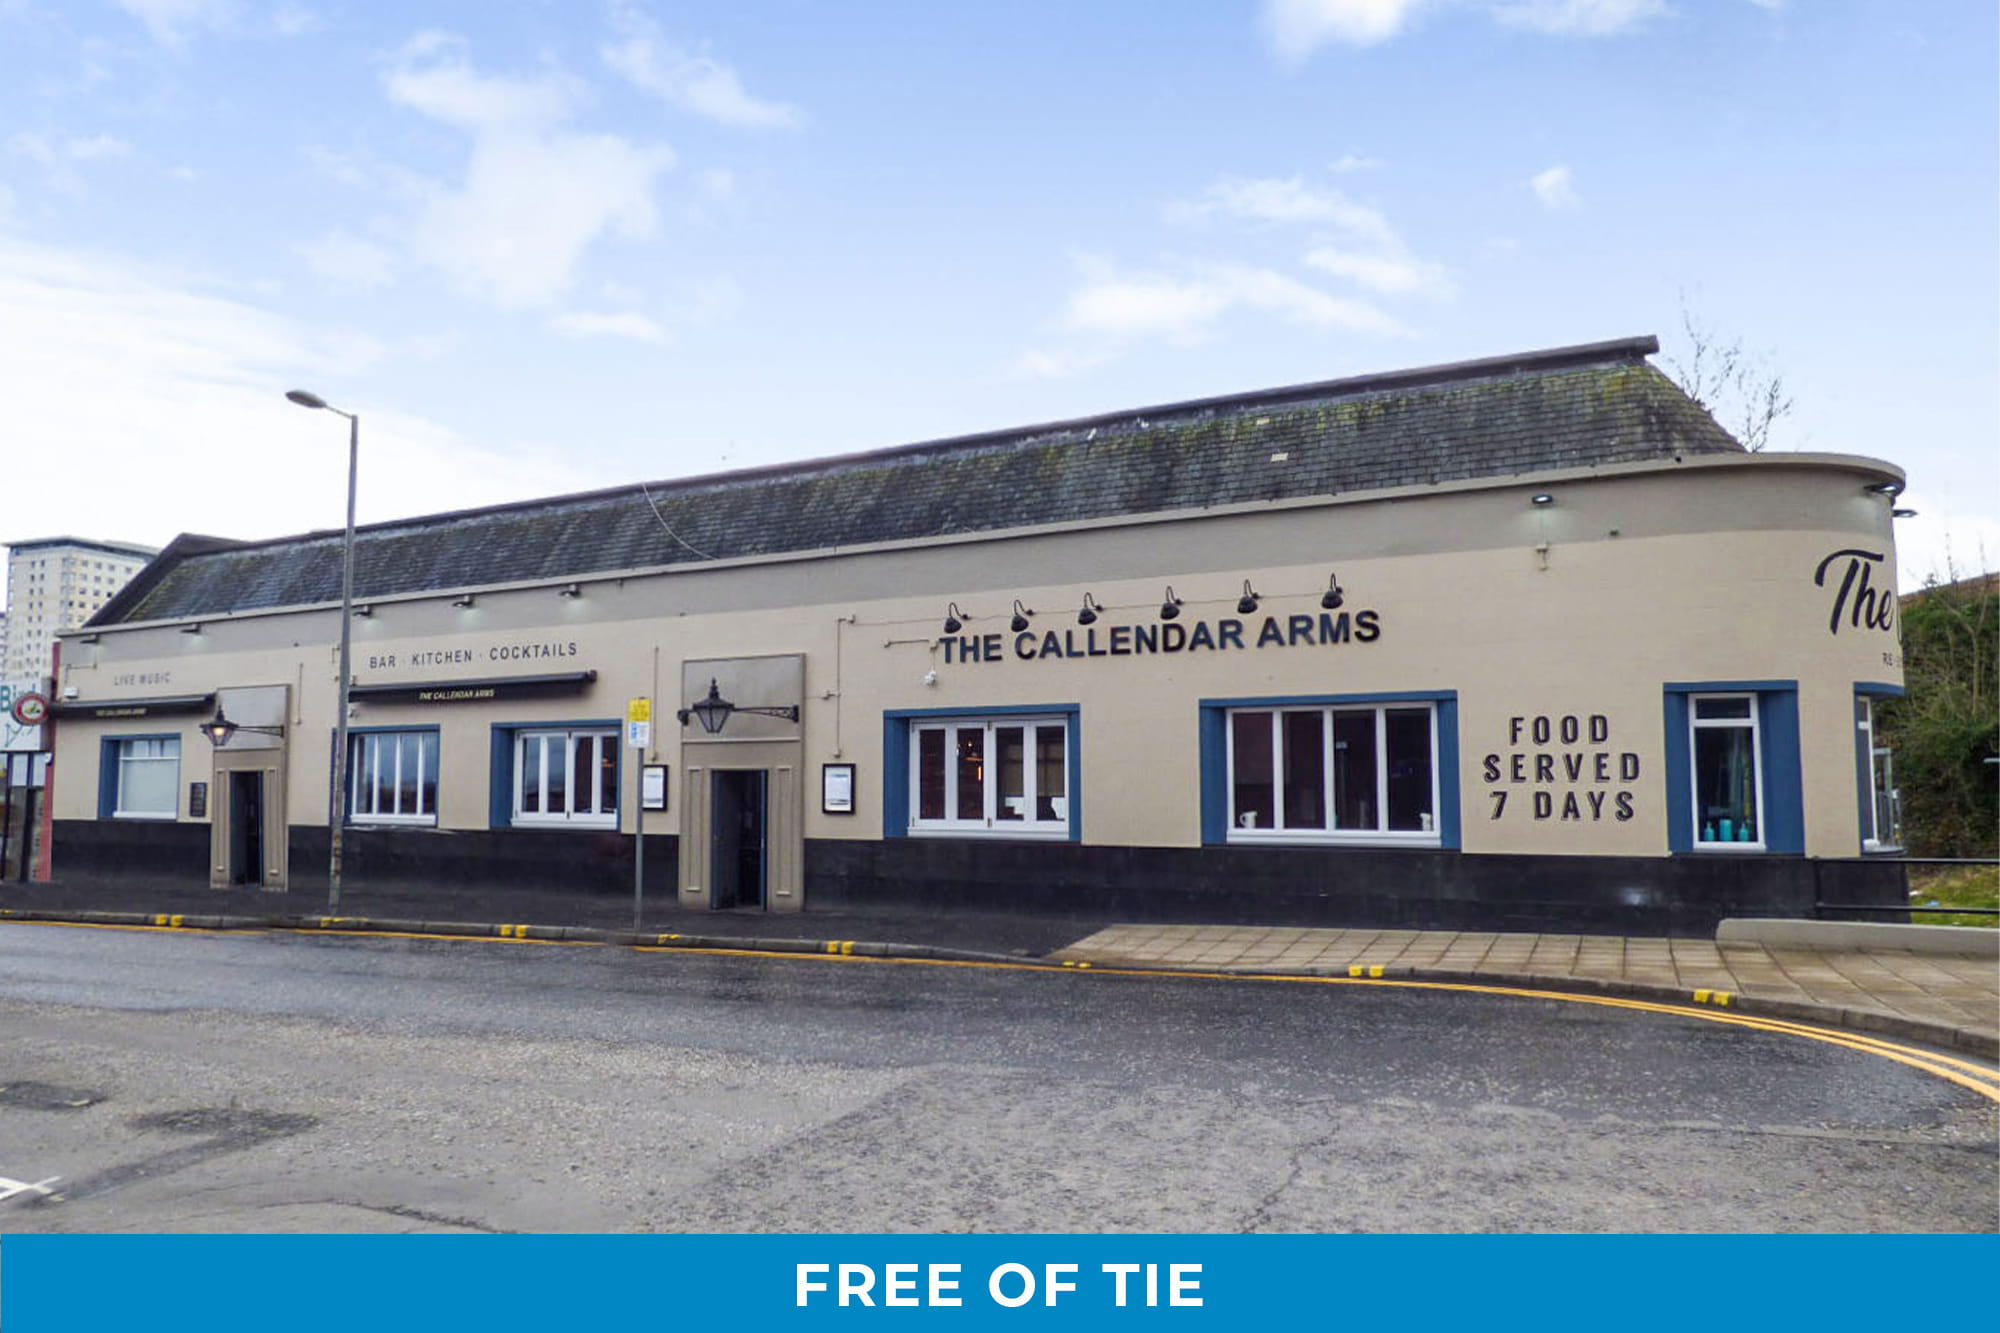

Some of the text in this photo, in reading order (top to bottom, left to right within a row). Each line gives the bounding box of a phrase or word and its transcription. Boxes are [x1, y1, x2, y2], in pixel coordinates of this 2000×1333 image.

[1814, 548, 1893, 635] The
[938, 609, 1381, 664] THE CALLENDAR ARMS
[369, 641, 578, 669] BAR KITCHEN COCKTAILS
[113, 670, 171, 687] LIVE MUSIC
[419, 691, 433, 700] THE
[1509, 714, 1609, 746] FOOD
[1482, 752, 1641, 783] SERVED
[1489, 790, 1635, 821] 7 DAYS
